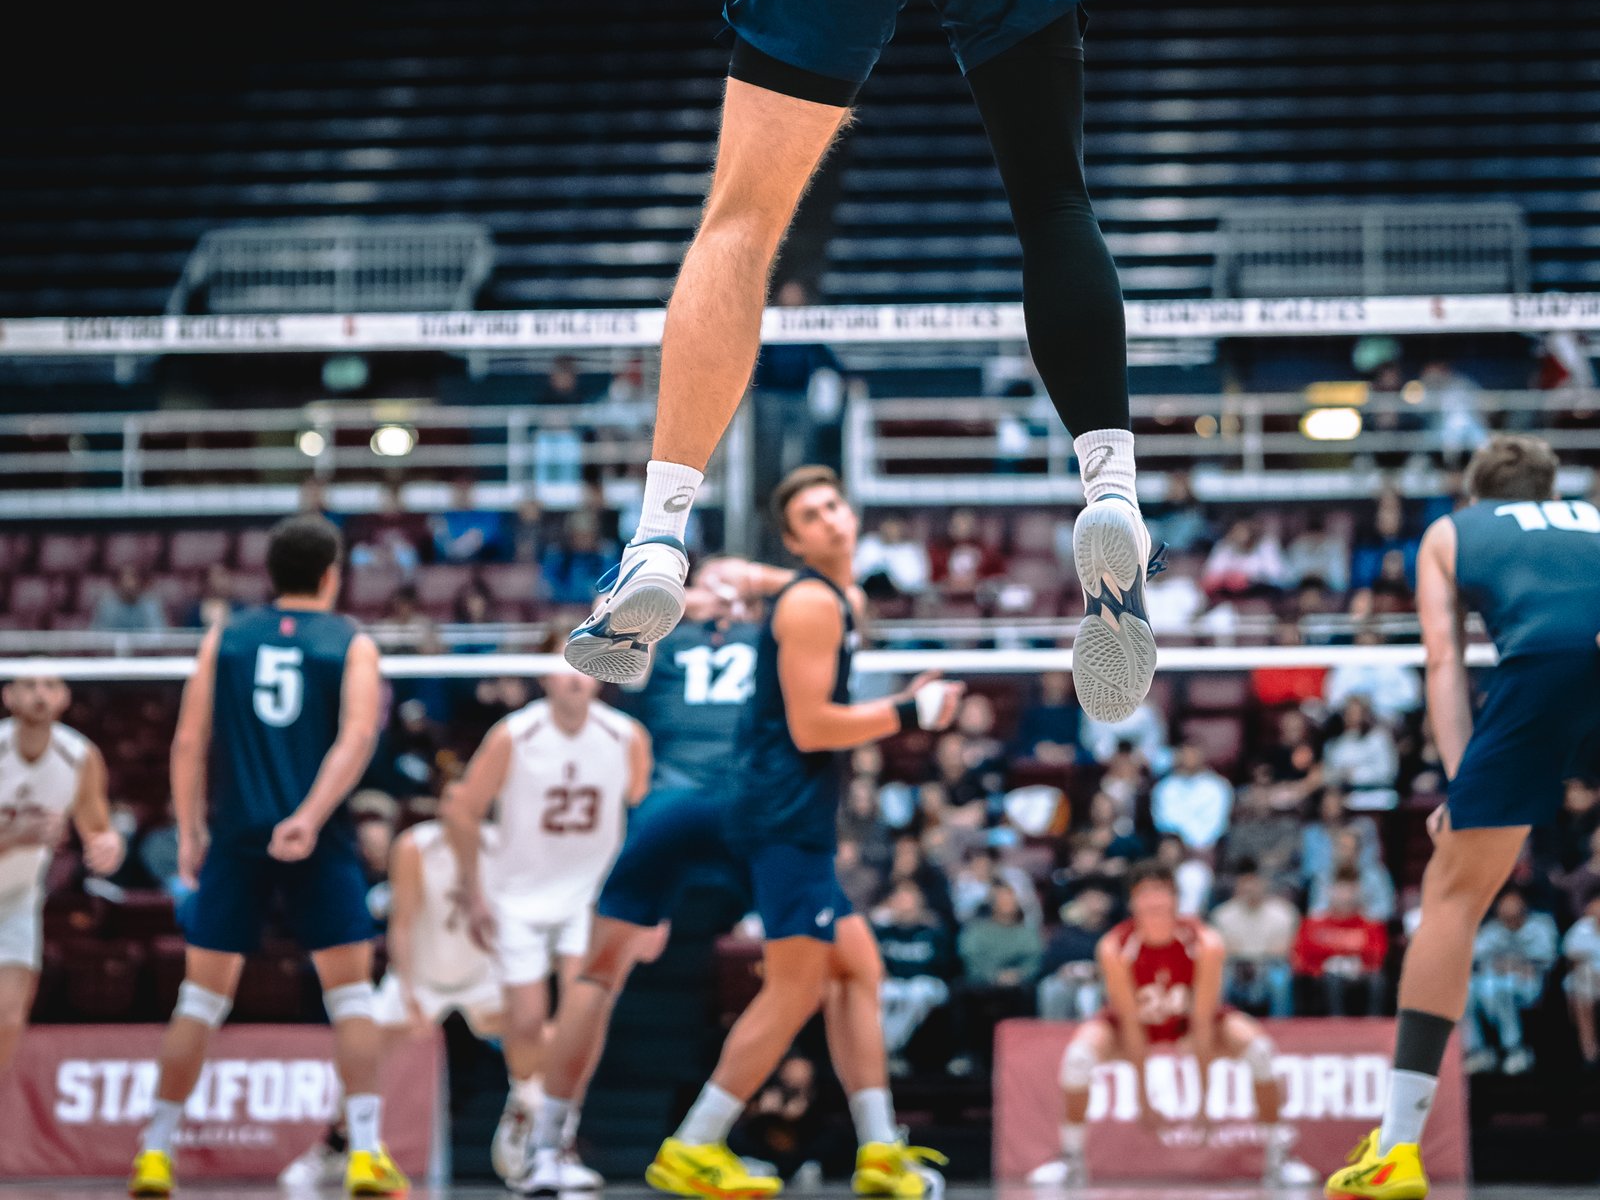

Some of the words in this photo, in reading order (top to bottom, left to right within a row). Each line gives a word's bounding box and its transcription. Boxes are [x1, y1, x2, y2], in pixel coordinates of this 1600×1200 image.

[253, 644, 305, 728] 5
[674, 643, 758, 705] 12
[541, 784, 604, 836] 23
